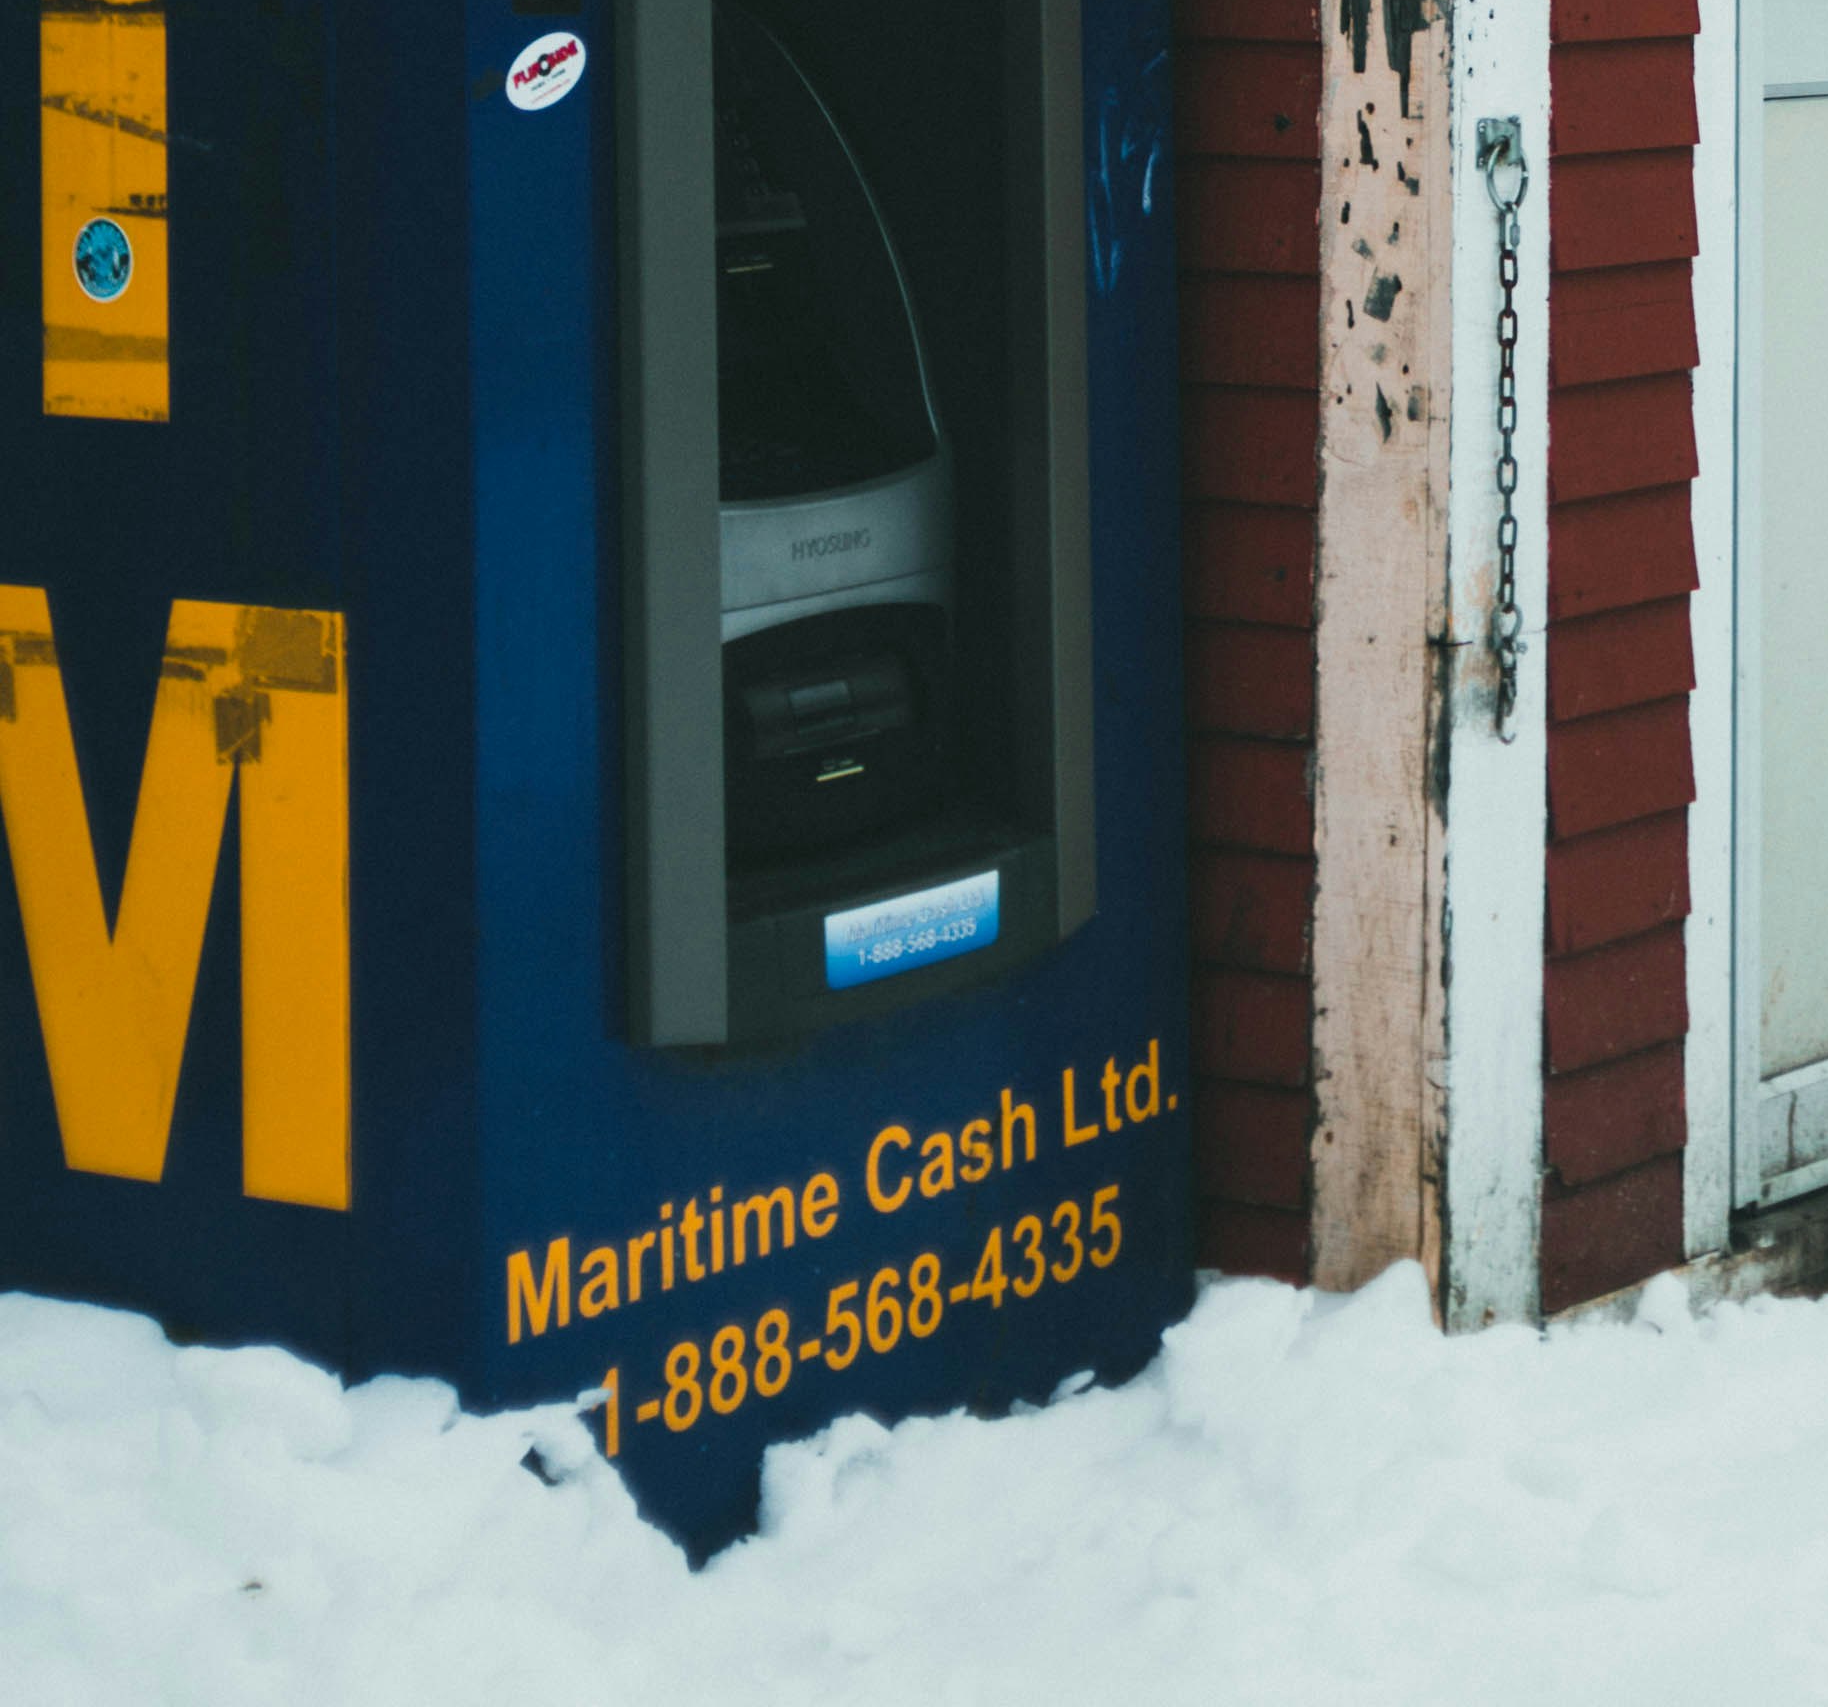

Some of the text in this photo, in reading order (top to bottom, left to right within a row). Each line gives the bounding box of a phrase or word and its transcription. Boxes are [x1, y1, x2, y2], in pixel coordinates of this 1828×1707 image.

[791, 527, 872, 561] HYOSUNG
[506, 1038, 1180, 1345] Maritime Cash Ltd.
[588, 1184, 1123, 1459] 1-888-568-4335
